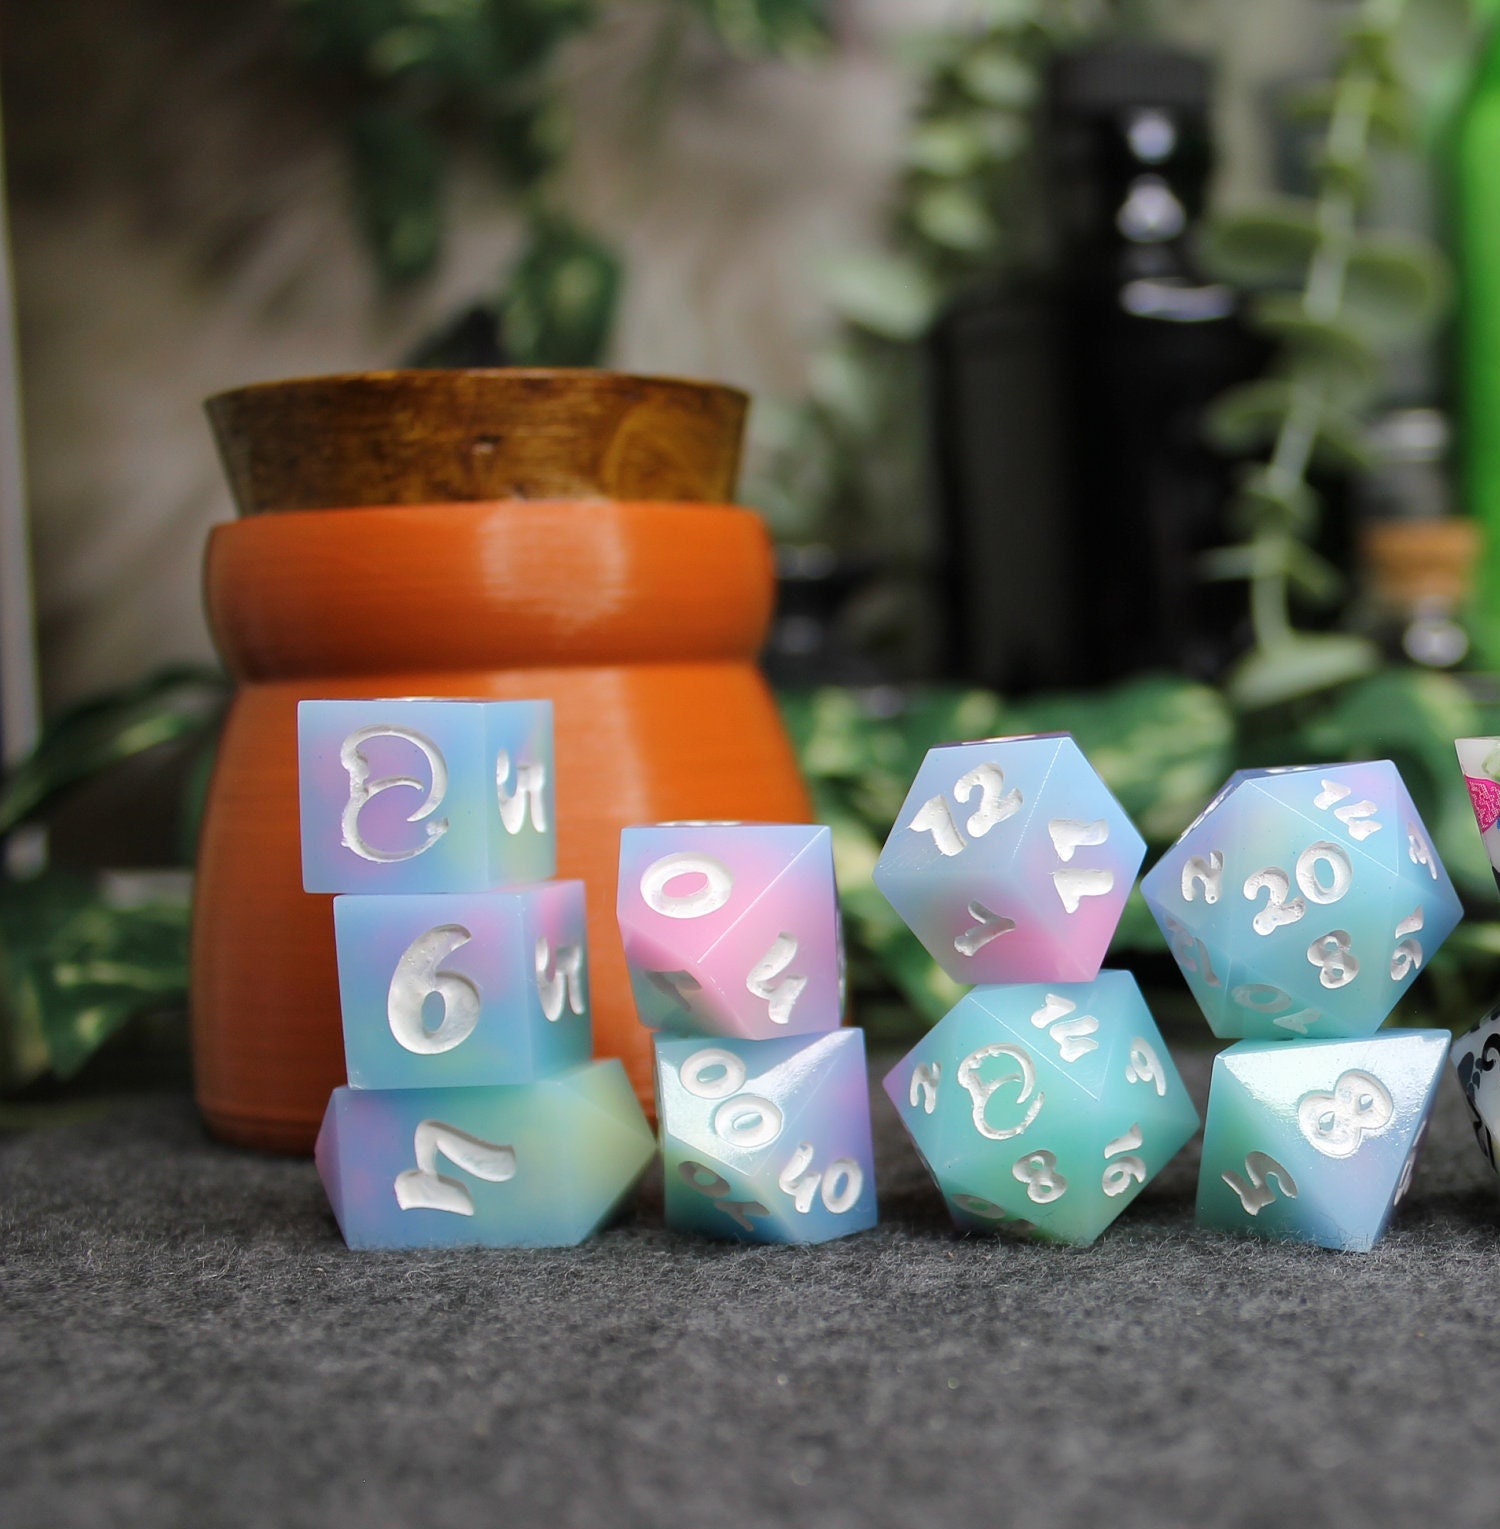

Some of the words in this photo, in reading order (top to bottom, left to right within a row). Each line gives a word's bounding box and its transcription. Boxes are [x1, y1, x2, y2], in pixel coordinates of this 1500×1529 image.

[908, 762, 1025, 857] 12
[640, 851, 734, 919] 0
[1181, 850, 1224, 904] 2
[1243, 840, 1352, 937] 20
[388, 923, 481, 1055] 6
[746, 931, 808, 1025] 4
[1307, 929, 1360, 989] 8
[679, 1048, 783, 1148] 00
[910, 1061, 941, 1114] 2
[1297, 1068, 1394, 1159] 8
[778, 1141, 863, 1215] 40
[1012, 1150, 1067, 1204] 8
